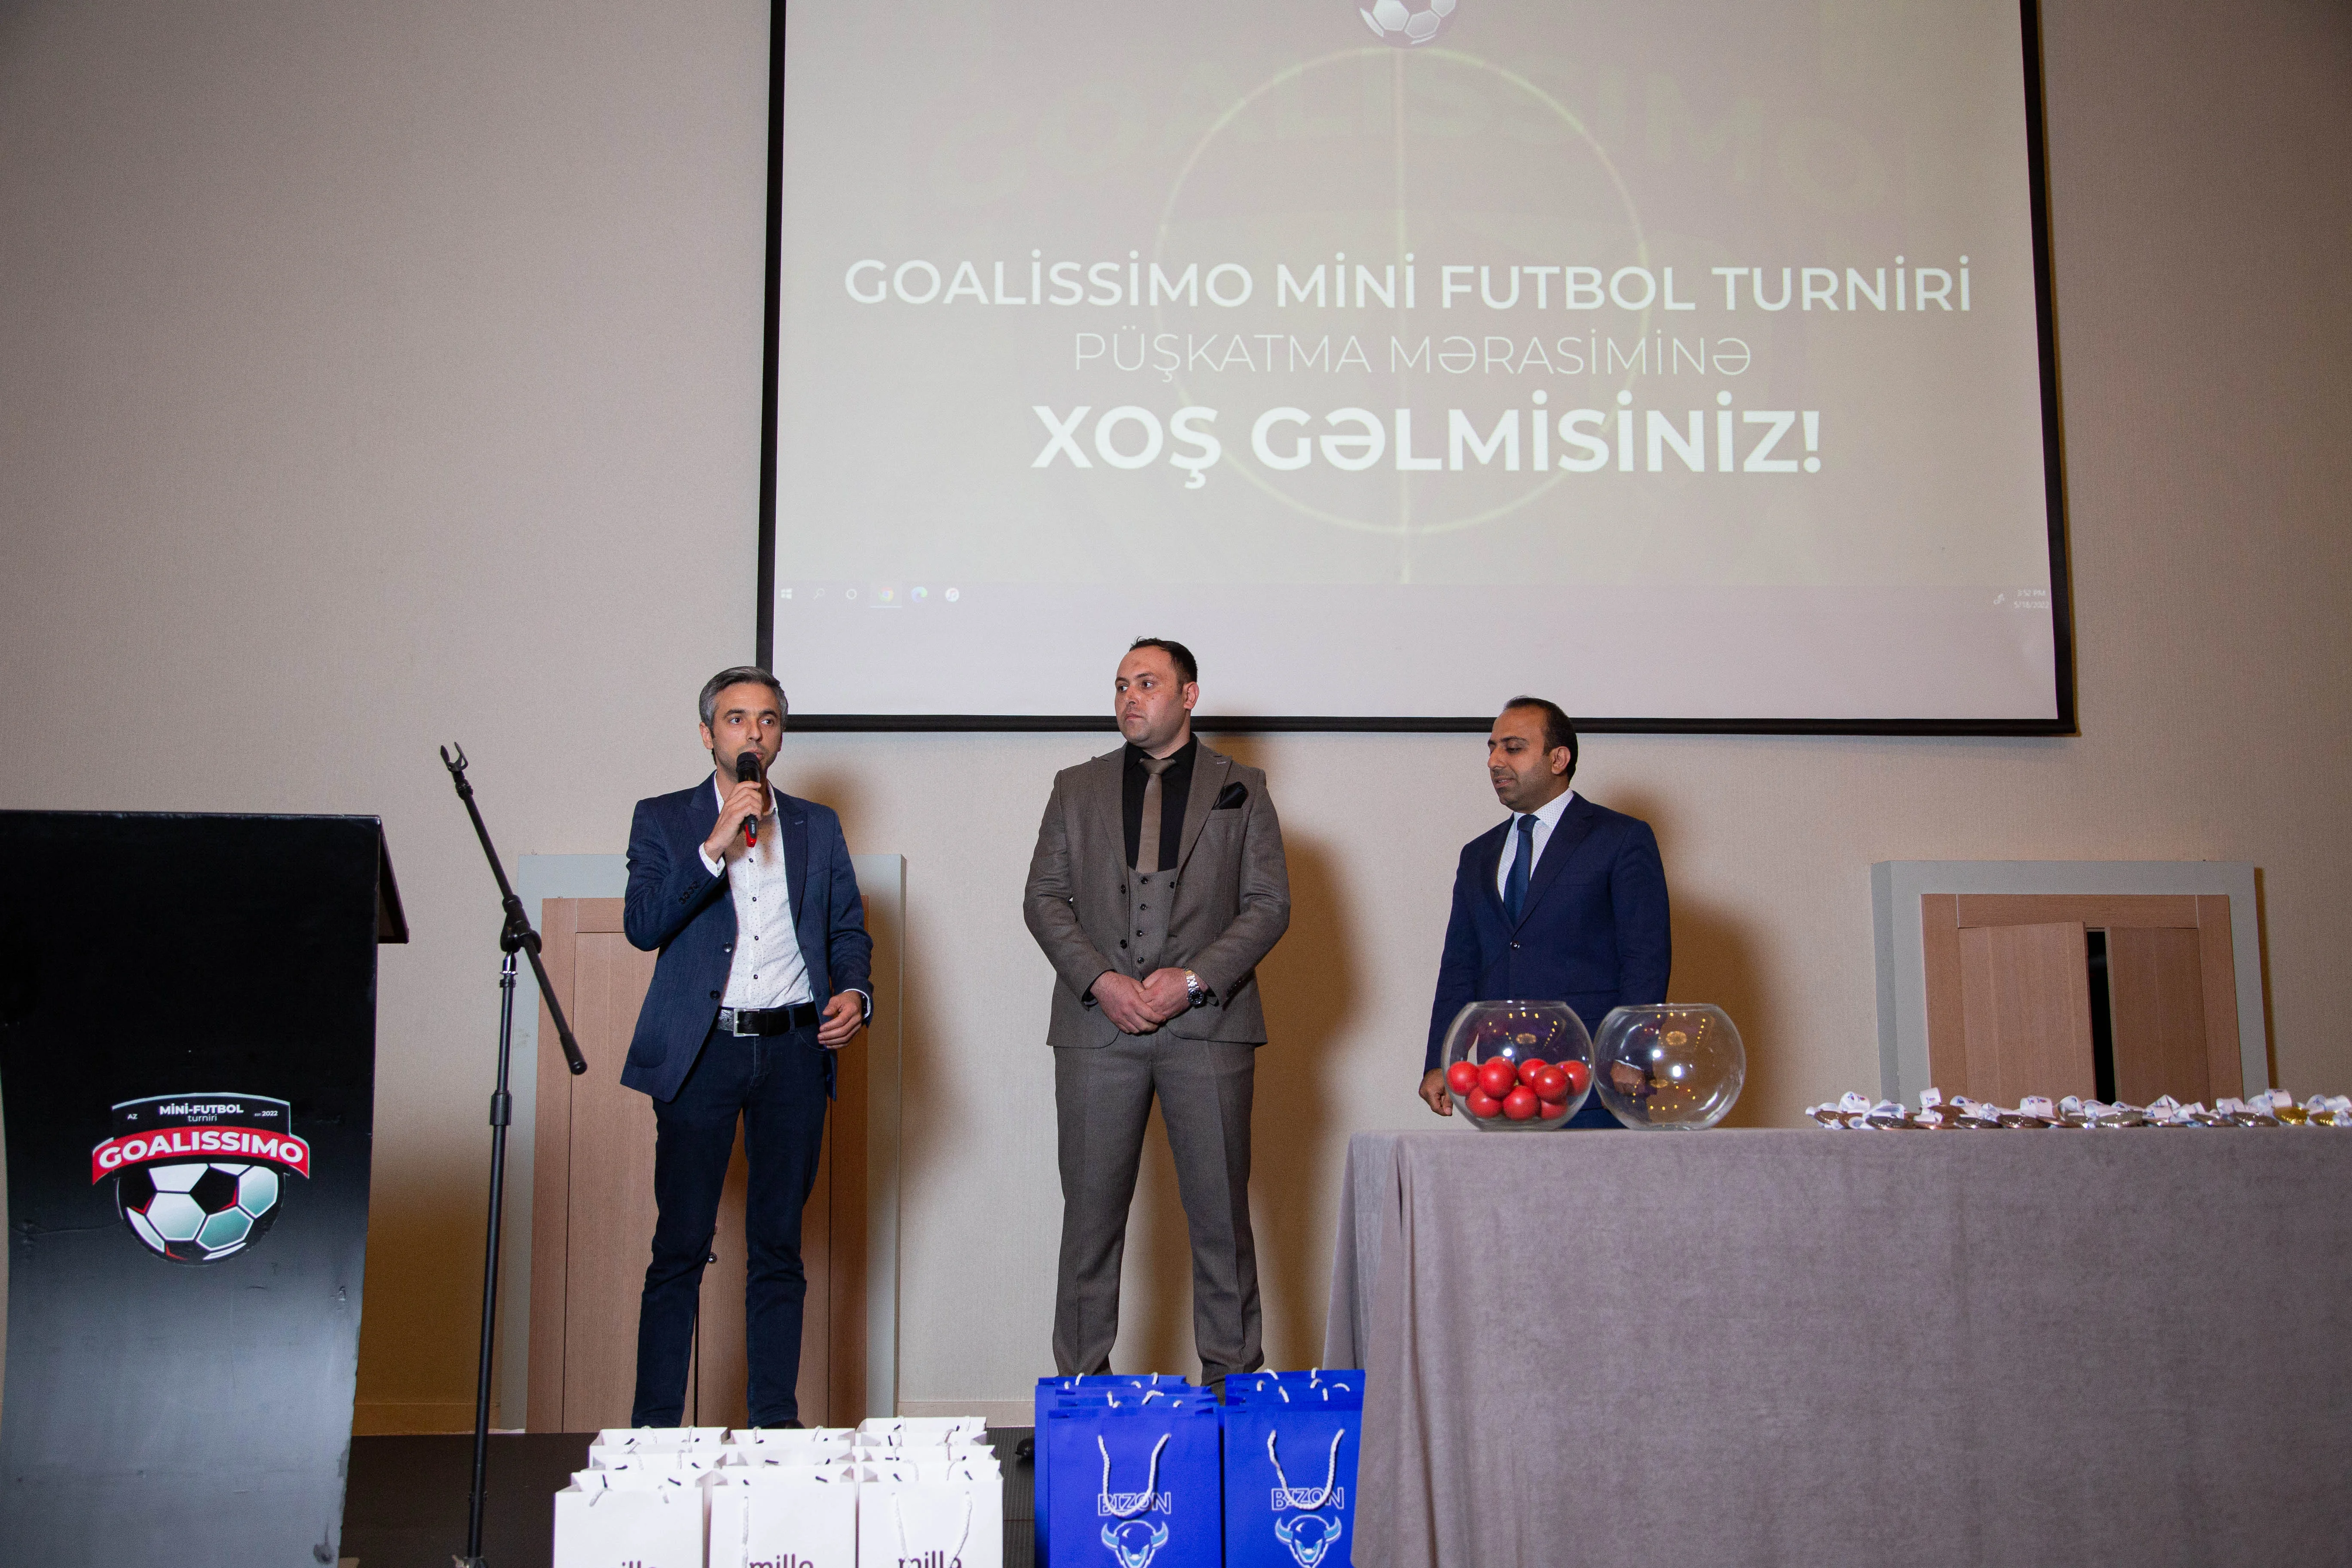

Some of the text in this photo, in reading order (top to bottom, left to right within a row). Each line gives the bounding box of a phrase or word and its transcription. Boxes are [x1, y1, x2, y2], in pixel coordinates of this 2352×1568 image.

[845, 249, 1971, 312] GOALİSSİMO MİNİ FUTBOL TURNİRİ
[1075, 325, 1752, 383] PÜŞKATMA MƏRASİMİNƏ
[1031, 389, 1821, 490] XOŞ GƏLMİSİNİZ!
[159, 1102, 244, 1115] MİNİ-FUTBOL
[188, 1114, 217, 1122] turniri
[98, 1131, 303, 1168] GOALISSIMO
[1098, 1491, 1172, 1516] BIZON
[1271, 1487, 1344, 1511] BIZON
